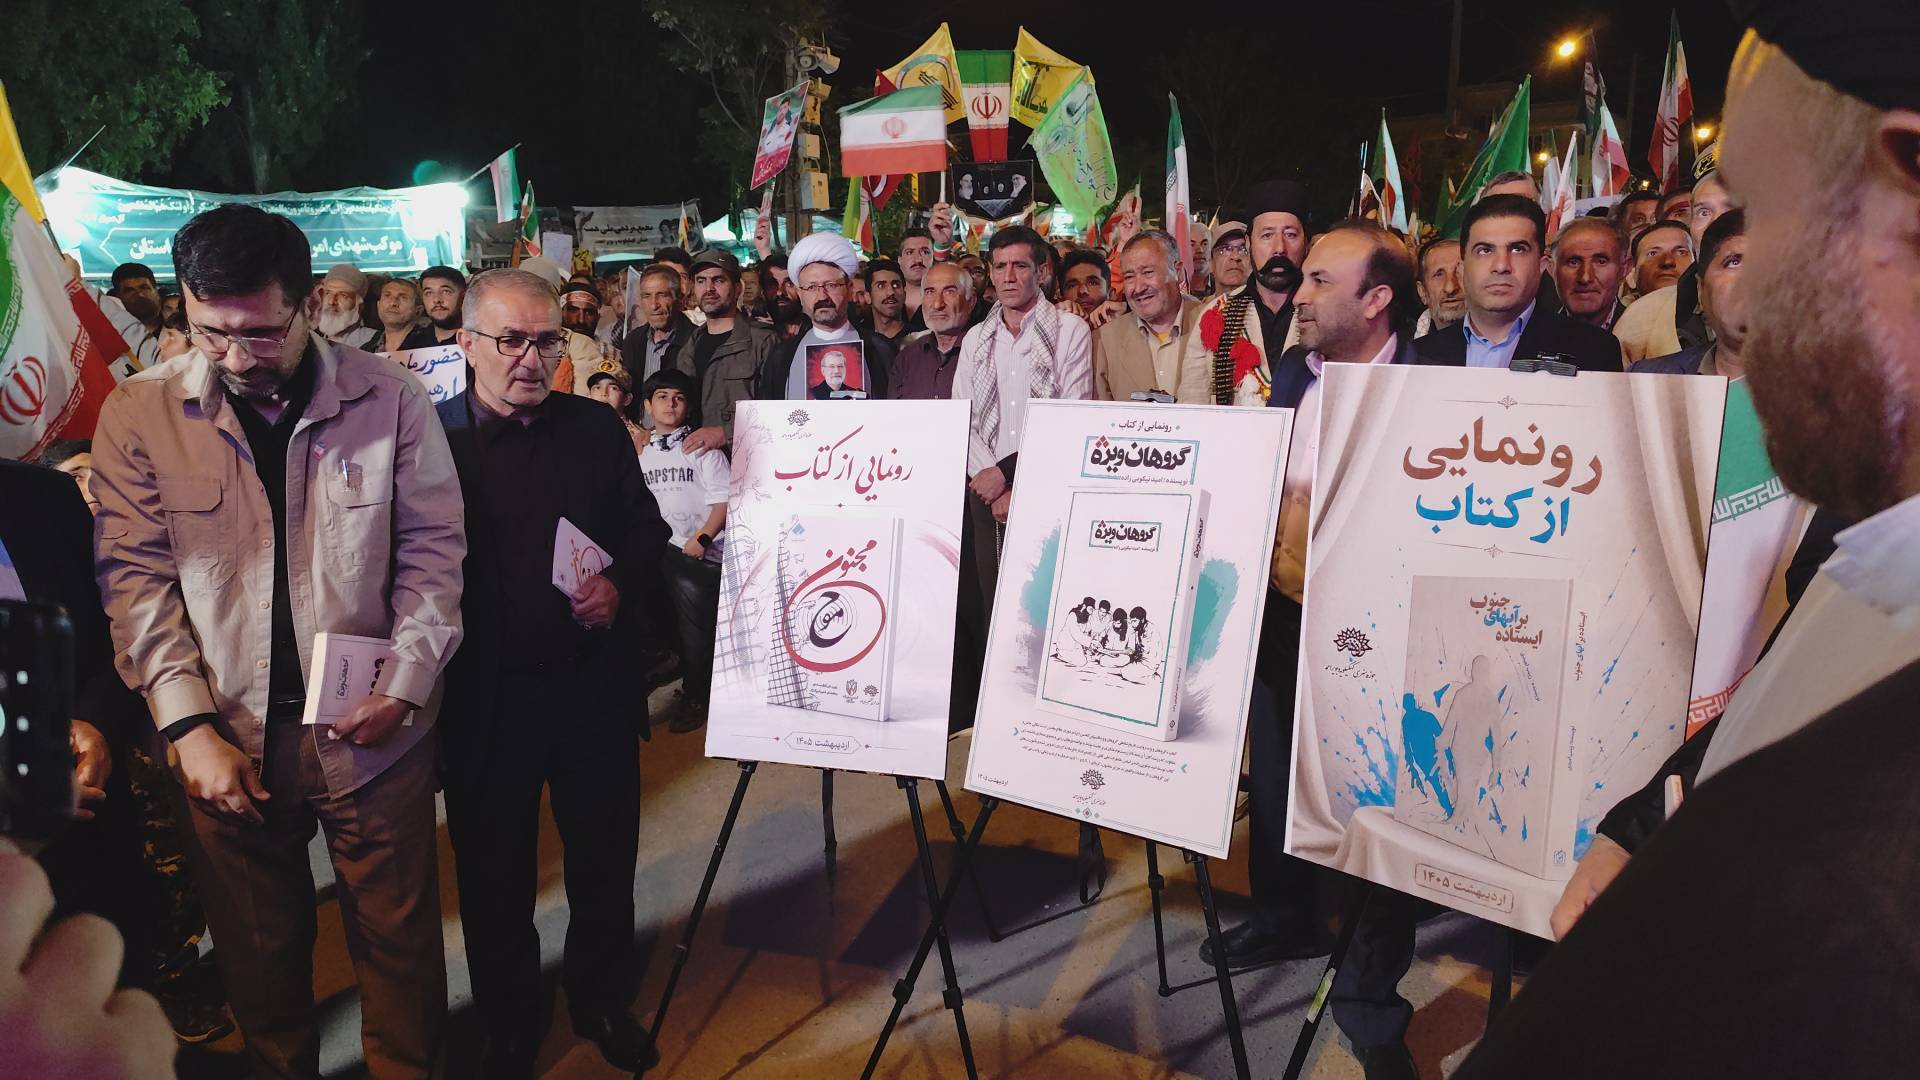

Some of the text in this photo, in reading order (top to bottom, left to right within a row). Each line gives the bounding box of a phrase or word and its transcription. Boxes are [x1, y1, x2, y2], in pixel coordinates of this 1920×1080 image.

[414, 348, 463, 375] حضور
[1118, 419, 1172, 433] رونمایی از کتاب
[774, 425, 913, 501] رونمایی از کتاب
[1090, 435, 1192, 473] گروهان ویژه
[1402, 415, 1603, 495] رونمایی
[642, 466, 694, 486] RAPSTAR
[1415, 482, 1571, 543] از کتاب
[1094, 520, 1157, 544] گروهان ویژه
[1469, 592, 1511, 615] جنوب
[1483, 604, 1529, 630] بر آبهای
[1496, 627, 1543, 650] ایستاده
[796, 736, 850, 751] اردیبهشت ۱۴۰۵
[1423, 869, 1506, 906] اردیبهشت ۱۴۰۵
